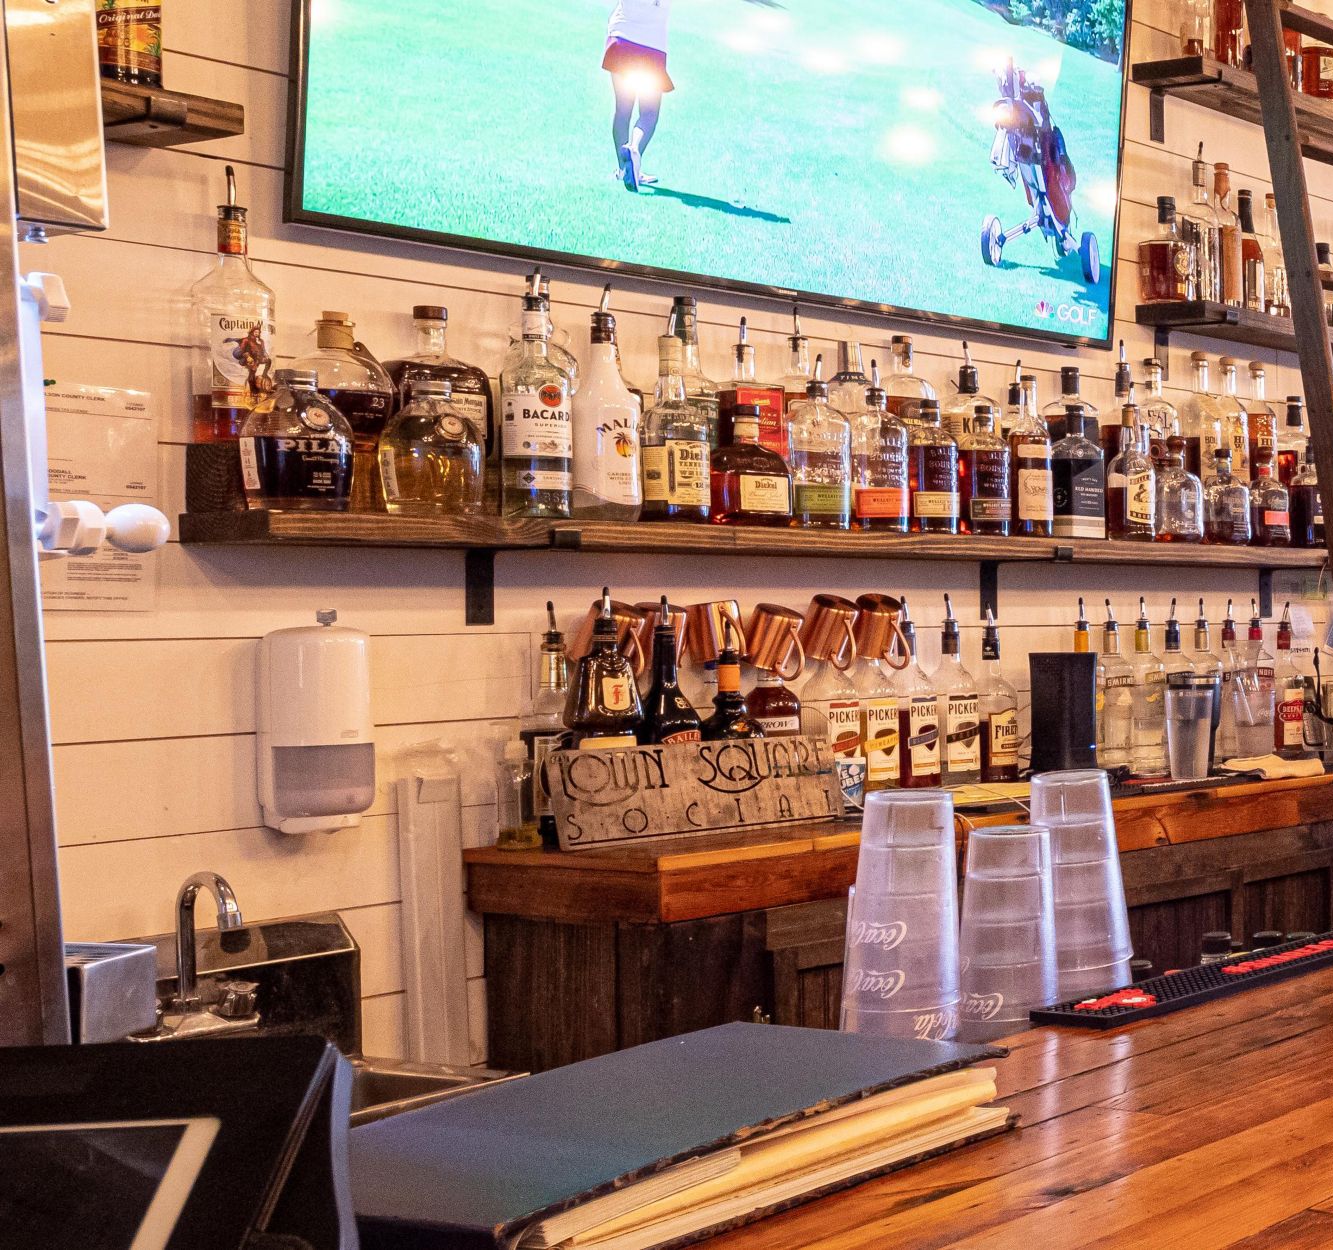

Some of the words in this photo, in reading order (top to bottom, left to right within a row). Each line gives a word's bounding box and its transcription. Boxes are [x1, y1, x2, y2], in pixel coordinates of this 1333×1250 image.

[1056, 304, 1097, 325] GOLF
[219, 317, 254, 331] Captain
[373, 398, 385, 408] 23
[277, 439, 353, 455] PILAR
[760, 718, 789, 730] RROW
[697, 738, 833, 794] SQUARE
[567, 789, 838, 841] SOCIAL
